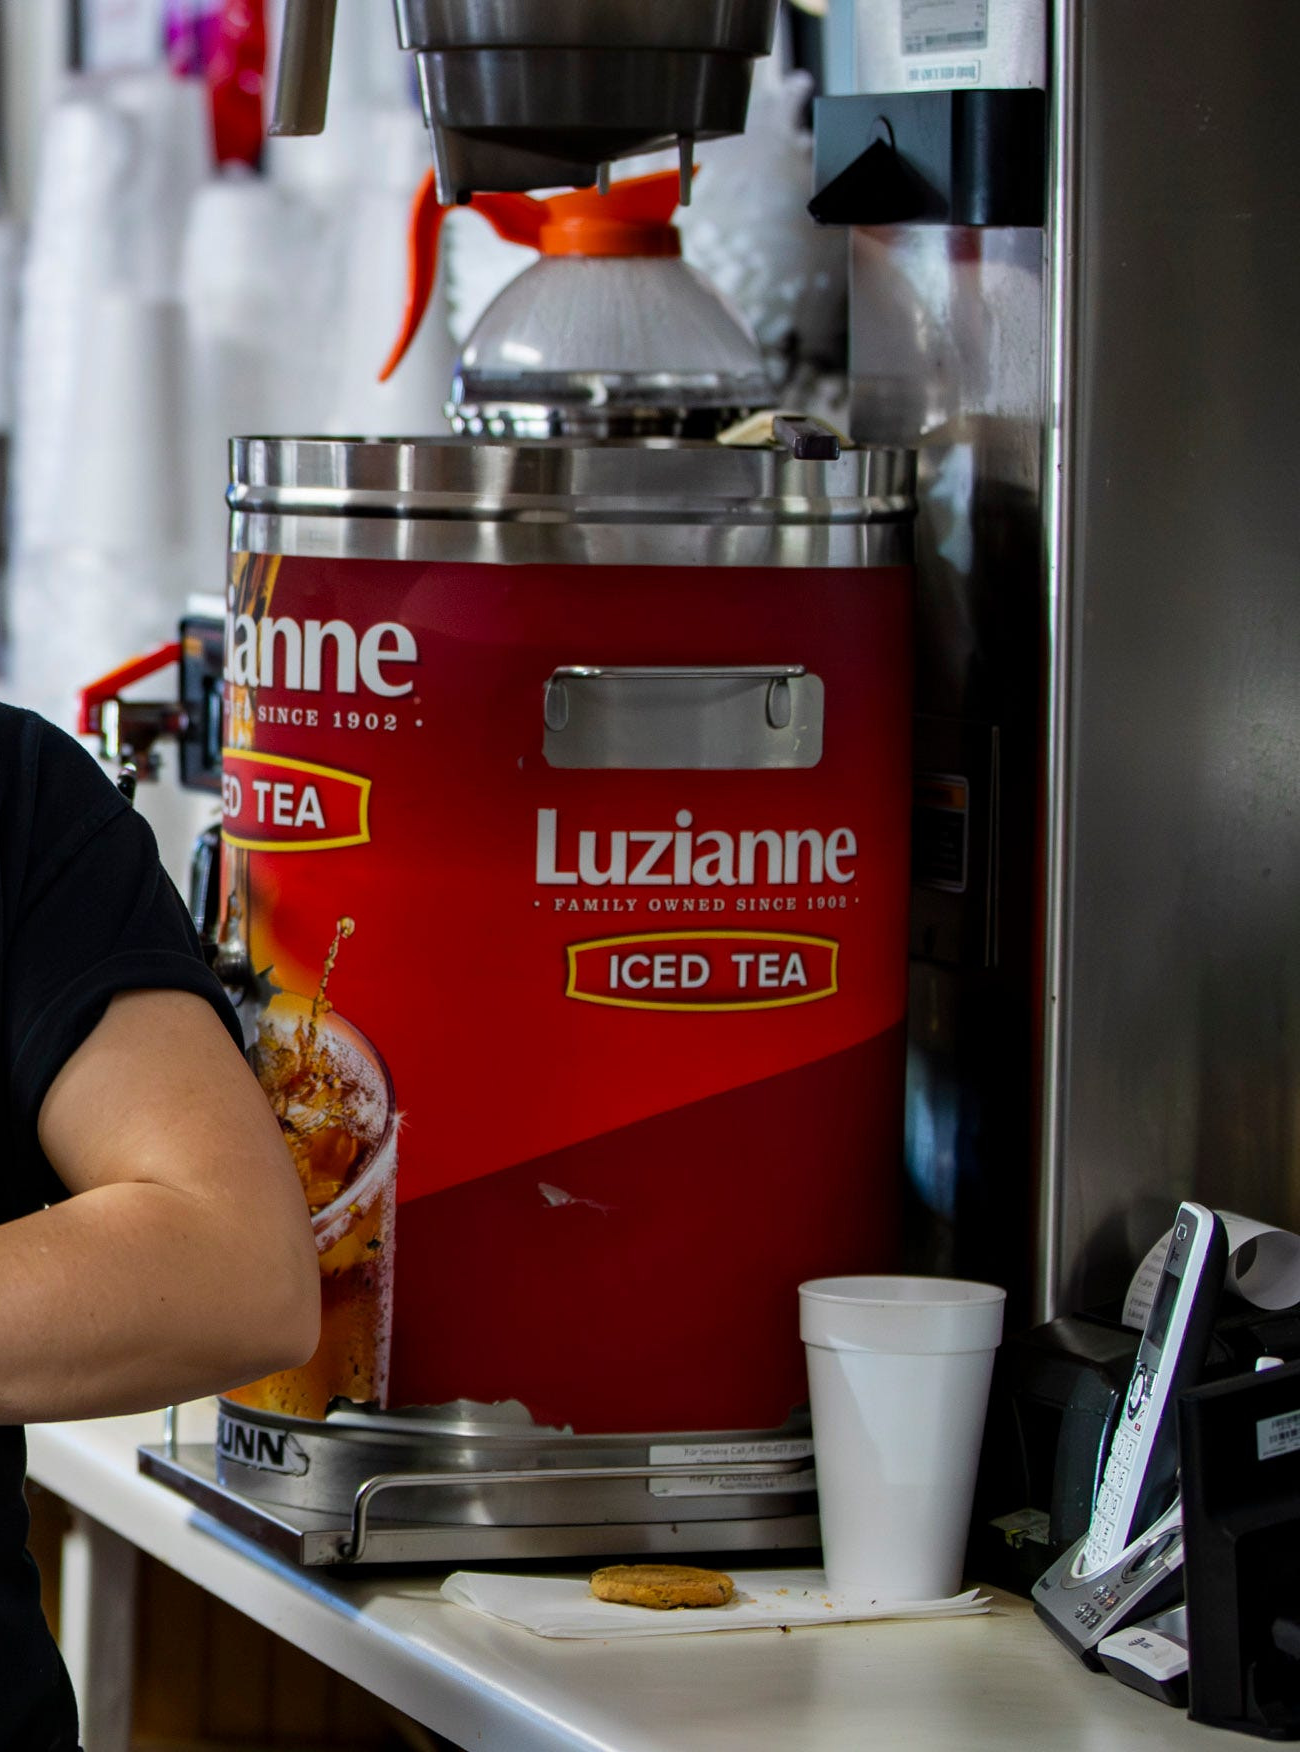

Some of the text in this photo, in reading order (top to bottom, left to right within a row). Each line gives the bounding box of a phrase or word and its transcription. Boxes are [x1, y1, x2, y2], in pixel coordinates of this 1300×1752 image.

[257, 705, 398, 731] SINCE 1902
[252, 780, 326, 830] TEA
[535, 807, 858, 887] Luzianne
[553, 895, 848, 913] FAMILY OWNED SINCE 1902
[609, 952, 809, 990] ICED TEA
